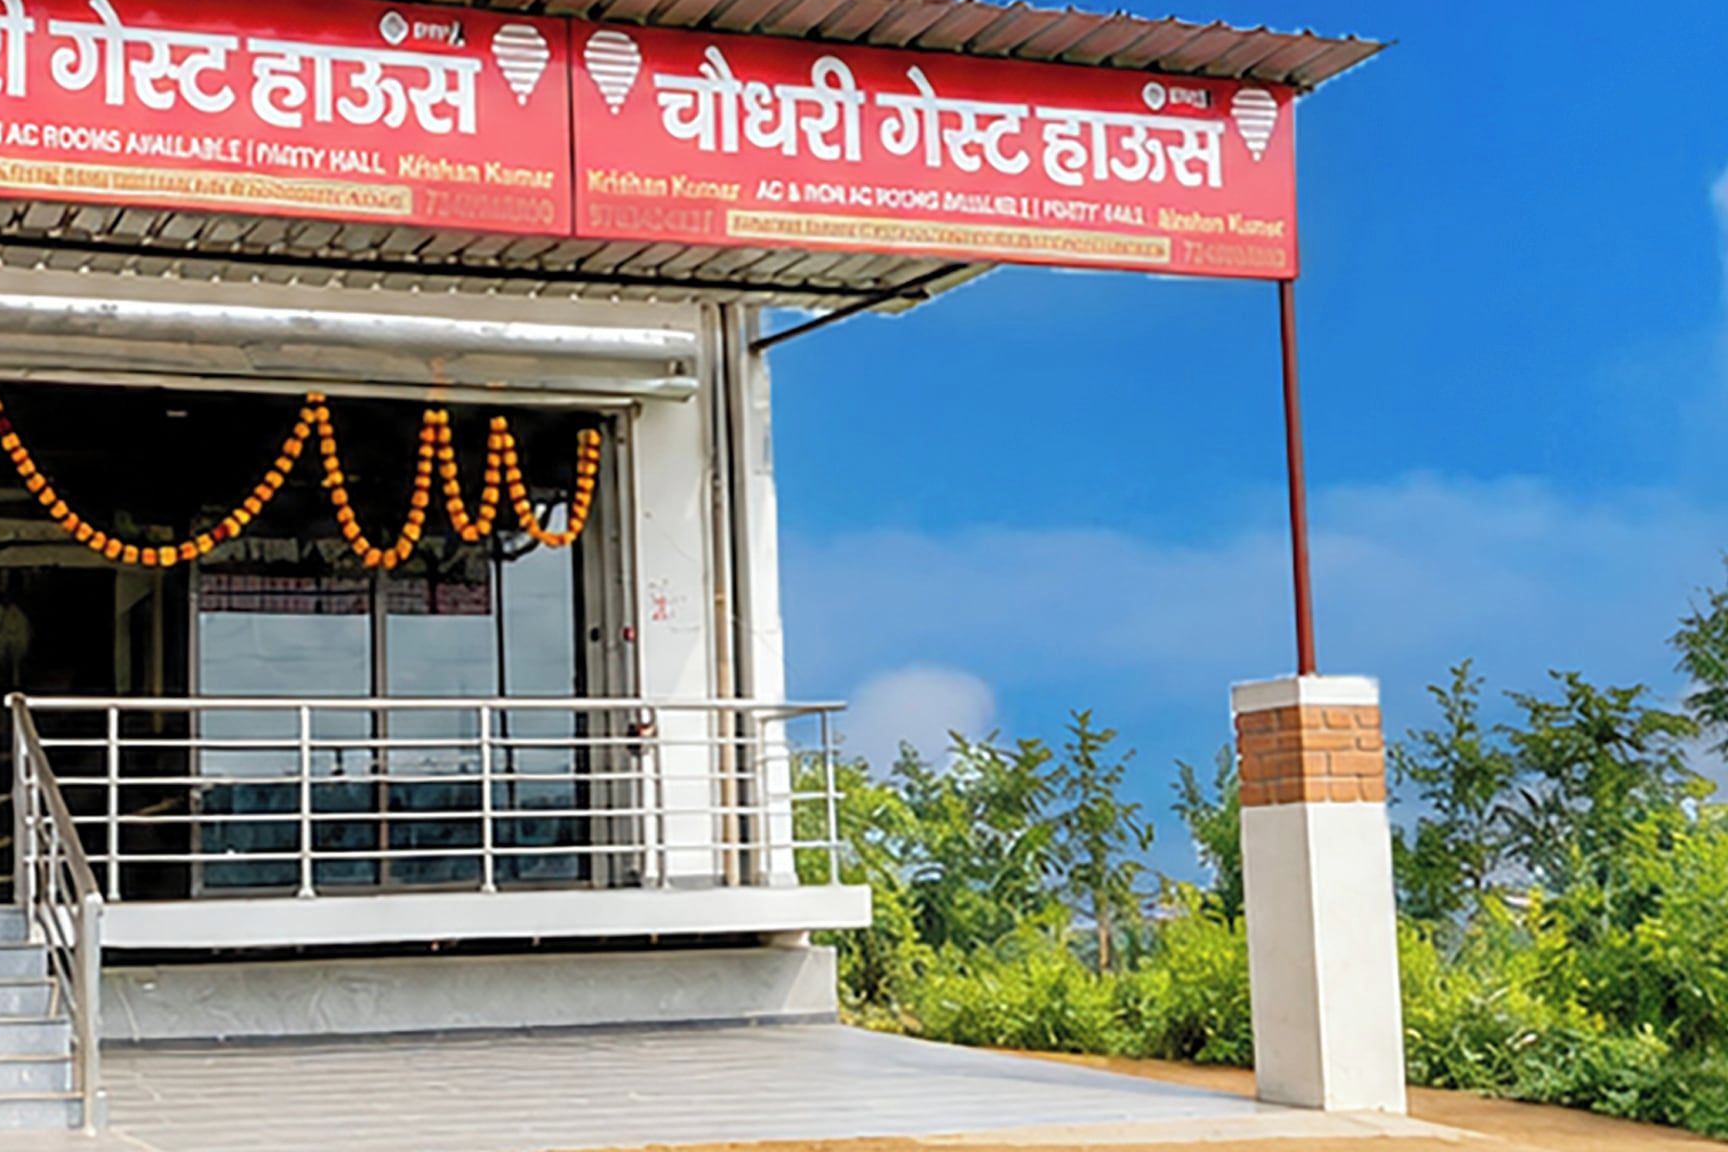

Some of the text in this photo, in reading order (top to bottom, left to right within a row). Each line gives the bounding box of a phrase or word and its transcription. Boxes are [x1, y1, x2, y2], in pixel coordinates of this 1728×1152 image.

[5, 123, 39, 146] AC
[246, 37, 482, 135] हाऊस
[653, 45, 1225, 189] चौधरी गेस्ट हाऊस
